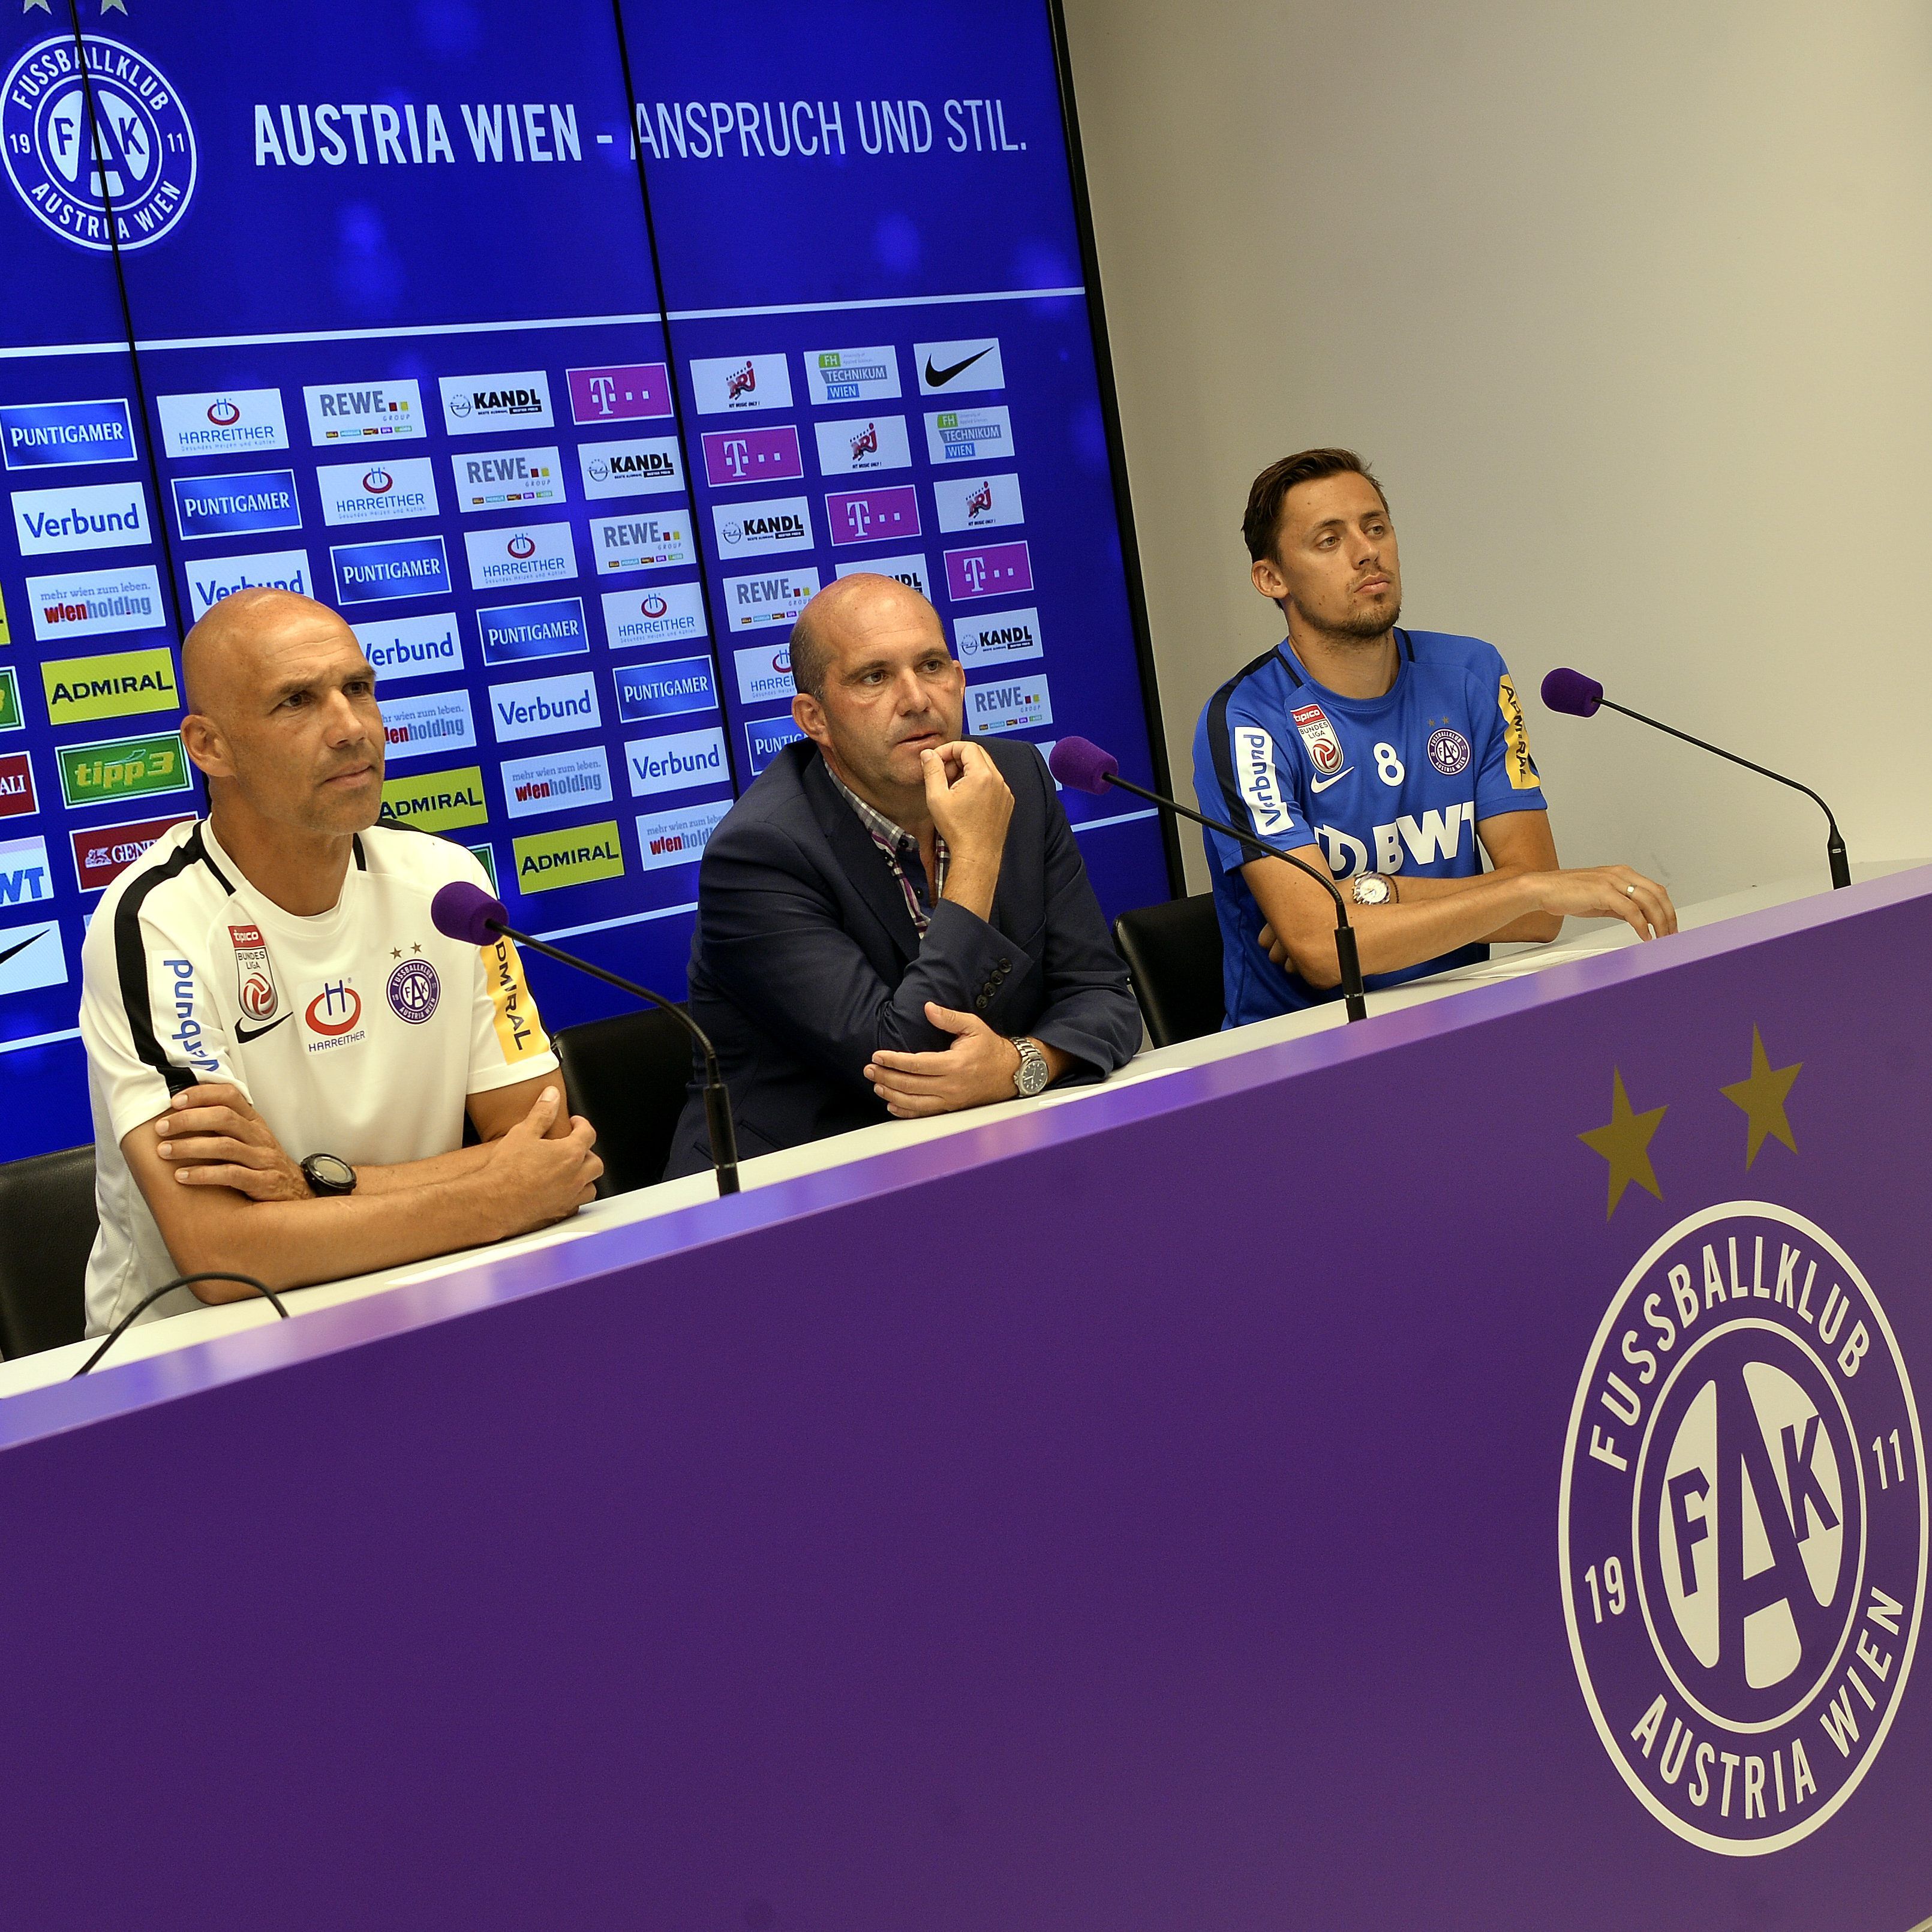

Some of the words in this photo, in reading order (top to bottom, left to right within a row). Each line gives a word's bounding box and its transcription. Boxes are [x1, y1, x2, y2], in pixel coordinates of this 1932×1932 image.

[11, 46, 169, 110] FUSSBALLKLUB
[10, 134, 30, 154] 19
[167, 133, 184, 152] 11
[255, 104, 455, 166] AUSTRIA
[461, 103, 582, 163] WIEN
[630, 101, 846, 160] ANSPRUCH
[856, 100, 933, 155] UND
[944, 99, 1027, 152] STIL.
[31, 183, 130, 239] AUSTRIA
[134, 181, 181, 232] WIEN
[824, 354, 837, 366] FH
[827, 367, 885, 382] TECHNIKUM
[320, 390, 386, 417] REWE
[473, 389, 542, 410] KANDL
[830, 386, 857, 398] WIEN
[942, 415, 955, 426] FH
[10, 422, 125, 447] PUNTIGAMER
[179, 426, 275, 444] HARREITHER
[945, 426, 999, 442] TECHNIKUM
[948, 444, 972, 456] WIEN
[467, 458, 529, 483] REWE
[610, 452, 673, 473] KANDL
[185, 491, 291, 517] PUNTIGAMER
[336, 493, 425, 512] HARREITHER
[23, 503, 140, 539] Verbund
[744, 514, 804, 535] KANDL
[603, 521, 661, 547] REWE
[343, 558, 441, 584] PUNTIGAMER
[483, 558, 566, 577] HARREITHER
[40, 588, 68, 601] mehr
[70, 586, 95, 598] wien
[97, 585, 119, 595] zum
[121, 581, 151, 593] leben.
[196, 570, 304, 606] Vernd
[737, 578, 792, 605] REWE
[488, 618, 579, 647] PUNTIGAMER
[618, 616, 695, 637] HARREITHER
[979, 626, 1033, 647] KANDL
[51, 671, 174, 705] ADMIRAL
[624, 675, 709, 703] PUNTIGAMER
[975, 686, 1023, 713] REWE
[393, 711, 416, 720] wien
[417, 709, 436, 718] zum
[438, 705, 464, 715] leben.
[497, 689, 592, 725] Verbund
[1299, 722, 1329, 735] BUNDES
[1308, 730, 1326, 739] LIGA
[512, 770, 534, 782] mehr
[536, 767, 557, 778] wien
[558, 765, 576, 775] zum
[576, 760, 602, 773] leben.
[633, 744, 720, 780] Verbund
[1373, 742, 1405, 786] 8
[379, 788, 483, 820] ADMIRAL
[647, 824, 668, 836] mehr
[669, 821, 687, 831] wien
[689, 818, 707, 827] zum
[521, 841, 619, 876] ADMIRAL
[238, 951, 265, 961] BUNDES
[246, 961, 262, 969] LIGA
[393, 965, 432, 987] FUSSBALLKLUB
[495, 941, 531, 1051] DMIRAL
[399, 1007, 425, 1020] AUSTRIA
[309, 1030, 366, 1053] HARREITHER
[1589, 1236, 1870, 1473] FUSSBALLKLUB
[1871, 1429, 1906, 1490] 11
[1585, 1556, 1626, 1624] 19
[1631, 1694, 1817, 1820] AUSTRIA
[1820, 1586, 1904, 1759] WIEN
